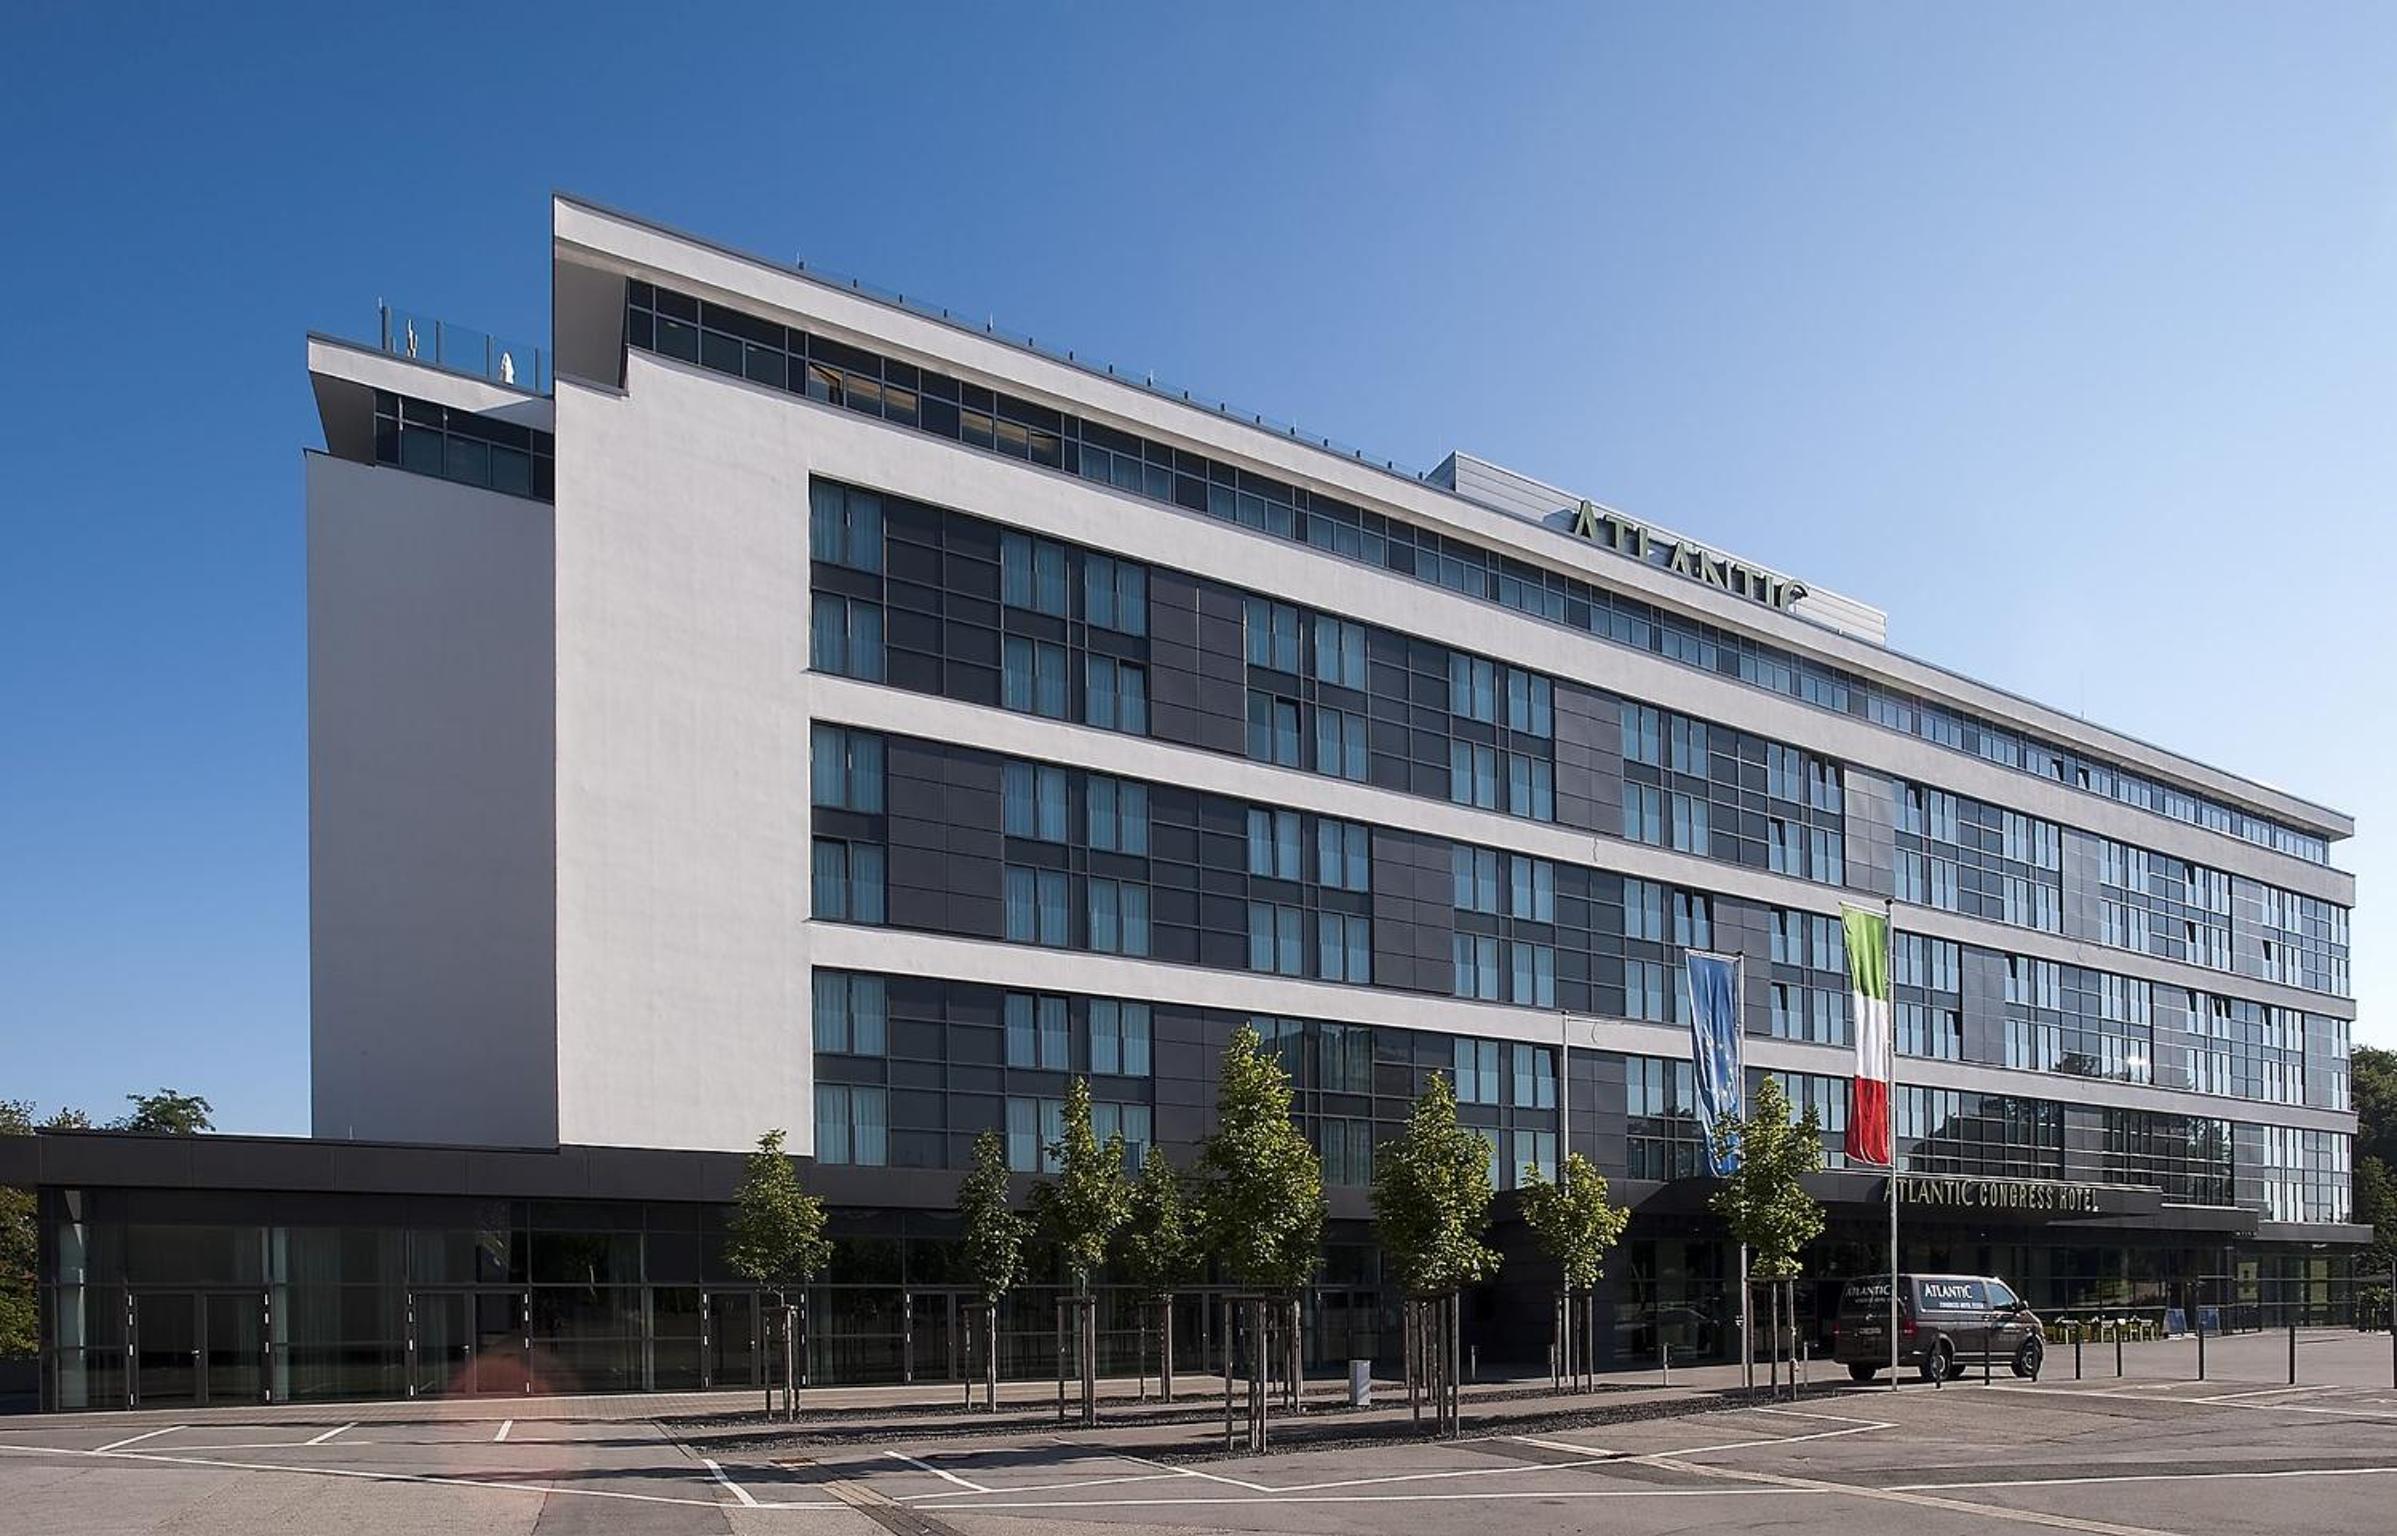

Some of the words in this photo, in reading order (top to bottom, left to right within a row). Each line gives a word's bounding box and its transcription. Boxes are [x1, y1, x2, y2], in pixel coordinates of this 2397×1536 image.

[1574, 500, 1808, 612] ATLANTIC
[1979, 1182, 2053, 1209] CONGRESS
[2059, 1187, 2100, 1212] HOTEL
[1925, 1283, 1973, 1299] ATLANTIC
